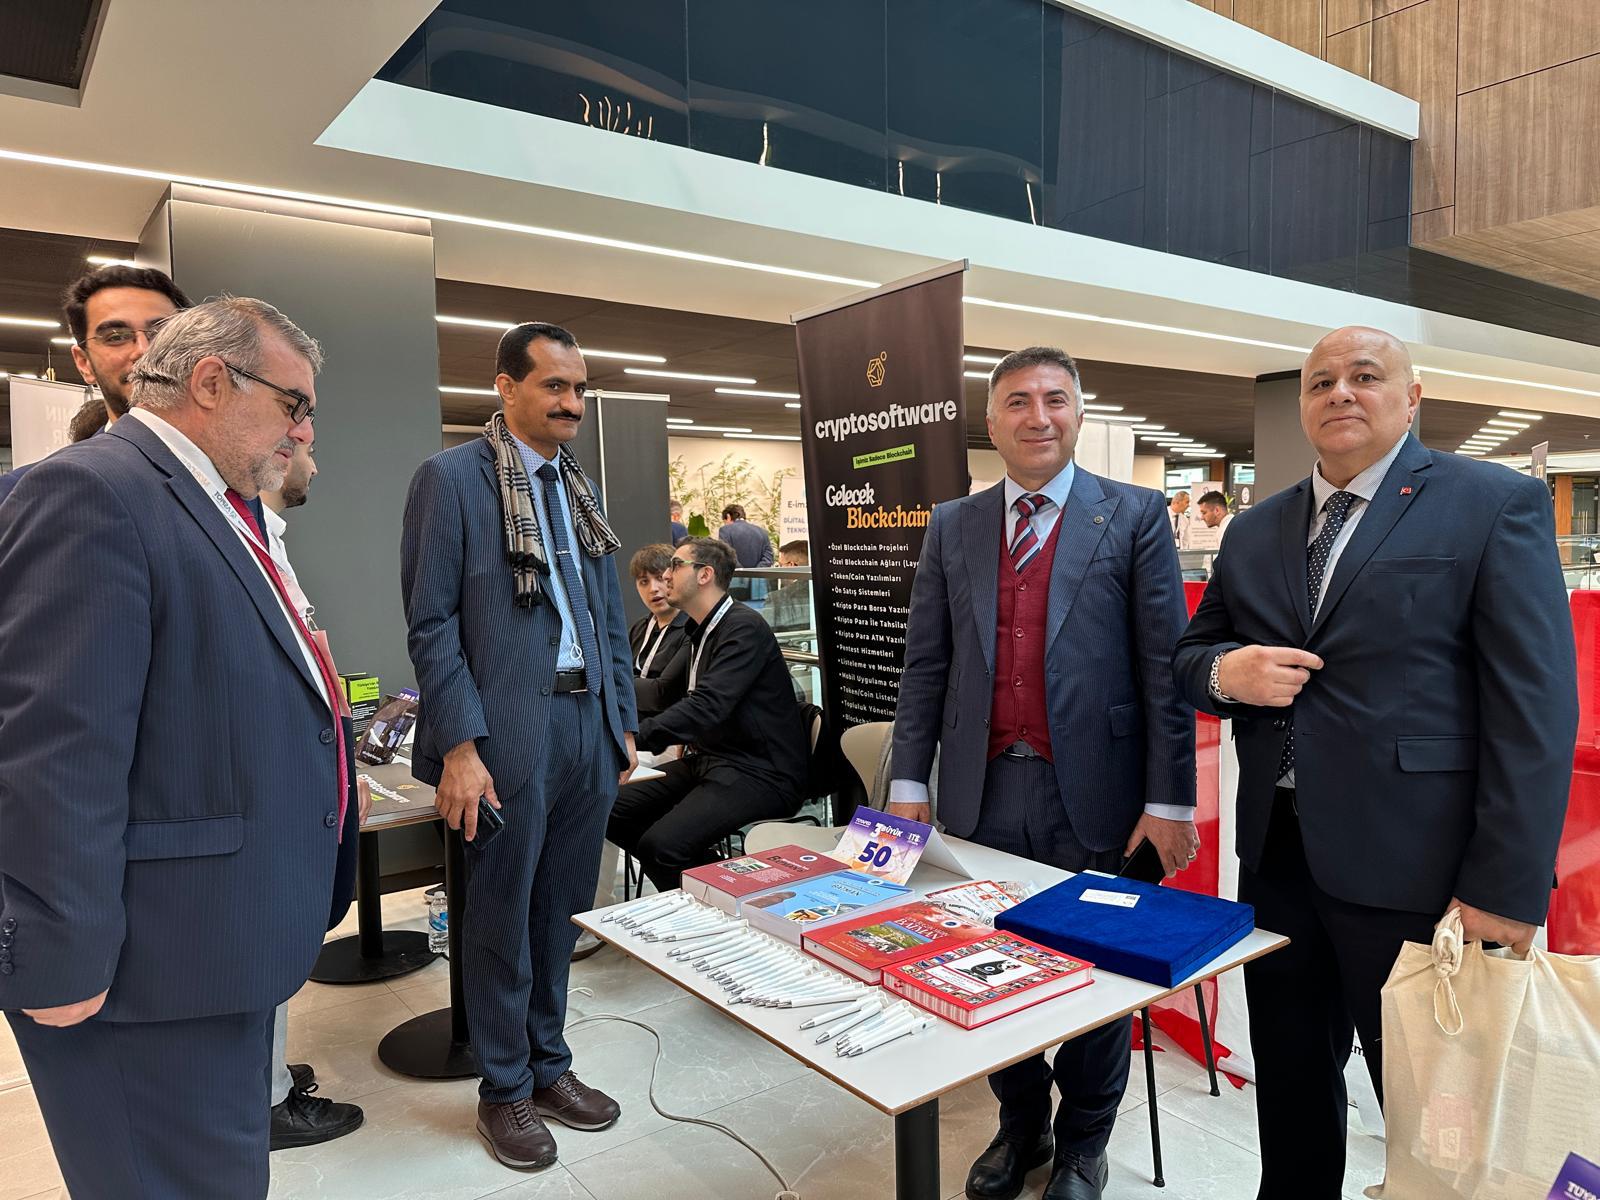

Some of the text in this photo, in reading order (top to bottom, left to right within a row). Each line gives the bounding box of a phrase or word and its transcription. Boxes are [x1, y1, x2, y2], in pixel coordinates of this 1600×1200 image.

[815, 400, 957, 442] cryptosoftware
[886, 448, 913, 459] Blockchain
[826, 482, 875, 507] Gelecek
[787, 500, 807, 509] E-im
[831, 543, 843, 551] Özel
[879, 544, 909, 553] Projeleri
[832, 557, 844, 565] Özel
[844, 558, 878, 566] Blockchain
[880, 559, 901, 568] Ağları
[833, 573, 901, 582] Token/Coin Yazılımları
[835, 586, 891, 597] Ön Satış Sistemleri
[836, 601, 852, 610] Kripto
[853, 603, 868, 611] Para
[869, 604, 887, 613] Borsa
[837, 616, 853, 624] Kripto
[854, 617, 869, 626] Para
[869, 617, 879, 627] İle
[838, 629, 854, 639] Kripto
[855, 632, 870, 640] Para
[871, 634, 885, 642] ATM
[839, 644, 894, 658] Pentest Hizmetleri
[840, 658, 867, 669] Listeleme
[841, 672, 856, 681] Mobil
[856, 675, 887, 687] Uygulama
[843, 686, 874, 698] Token/Coin
[844, 700, 867, 711] Topluluk
[858, 840, 892, 867] 50
